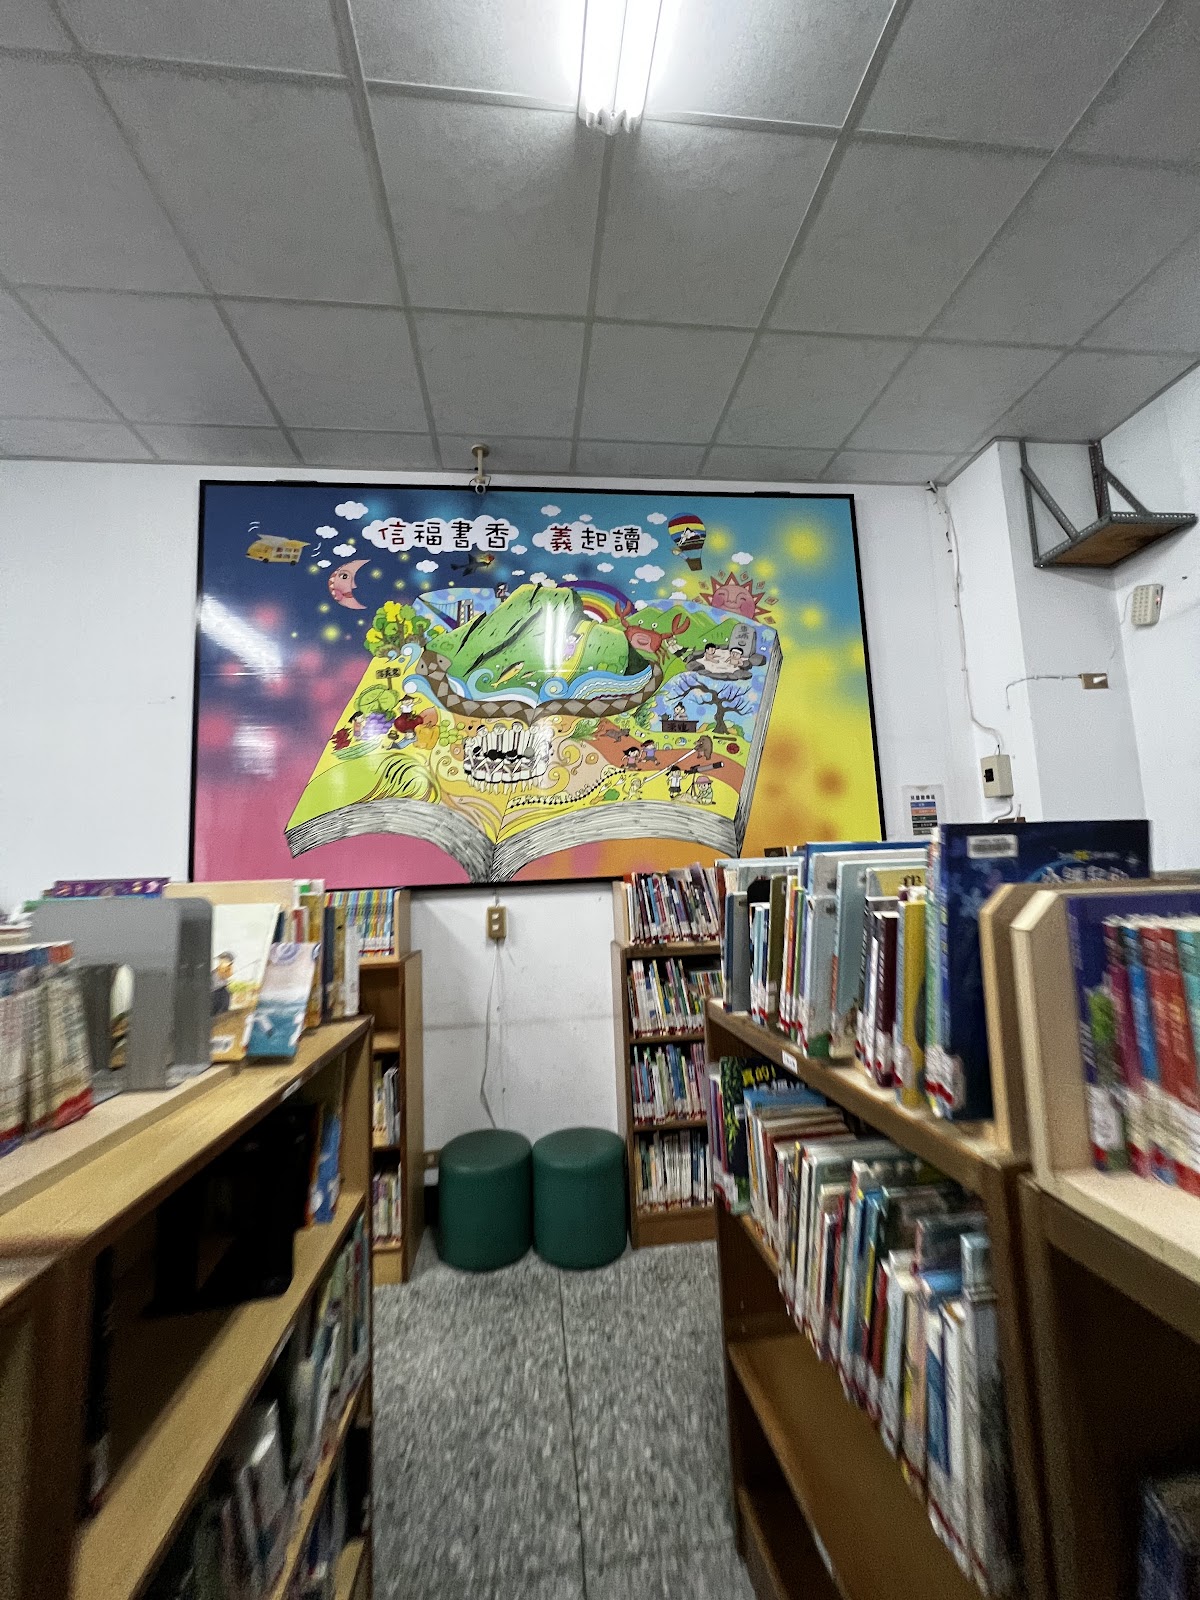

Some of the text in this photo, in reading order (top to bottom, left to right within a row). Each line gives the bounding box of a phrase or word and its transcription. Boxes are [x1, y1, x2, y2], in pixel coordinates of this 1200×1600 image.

[377, 521, 641, 554] 信福書香 義起讀
